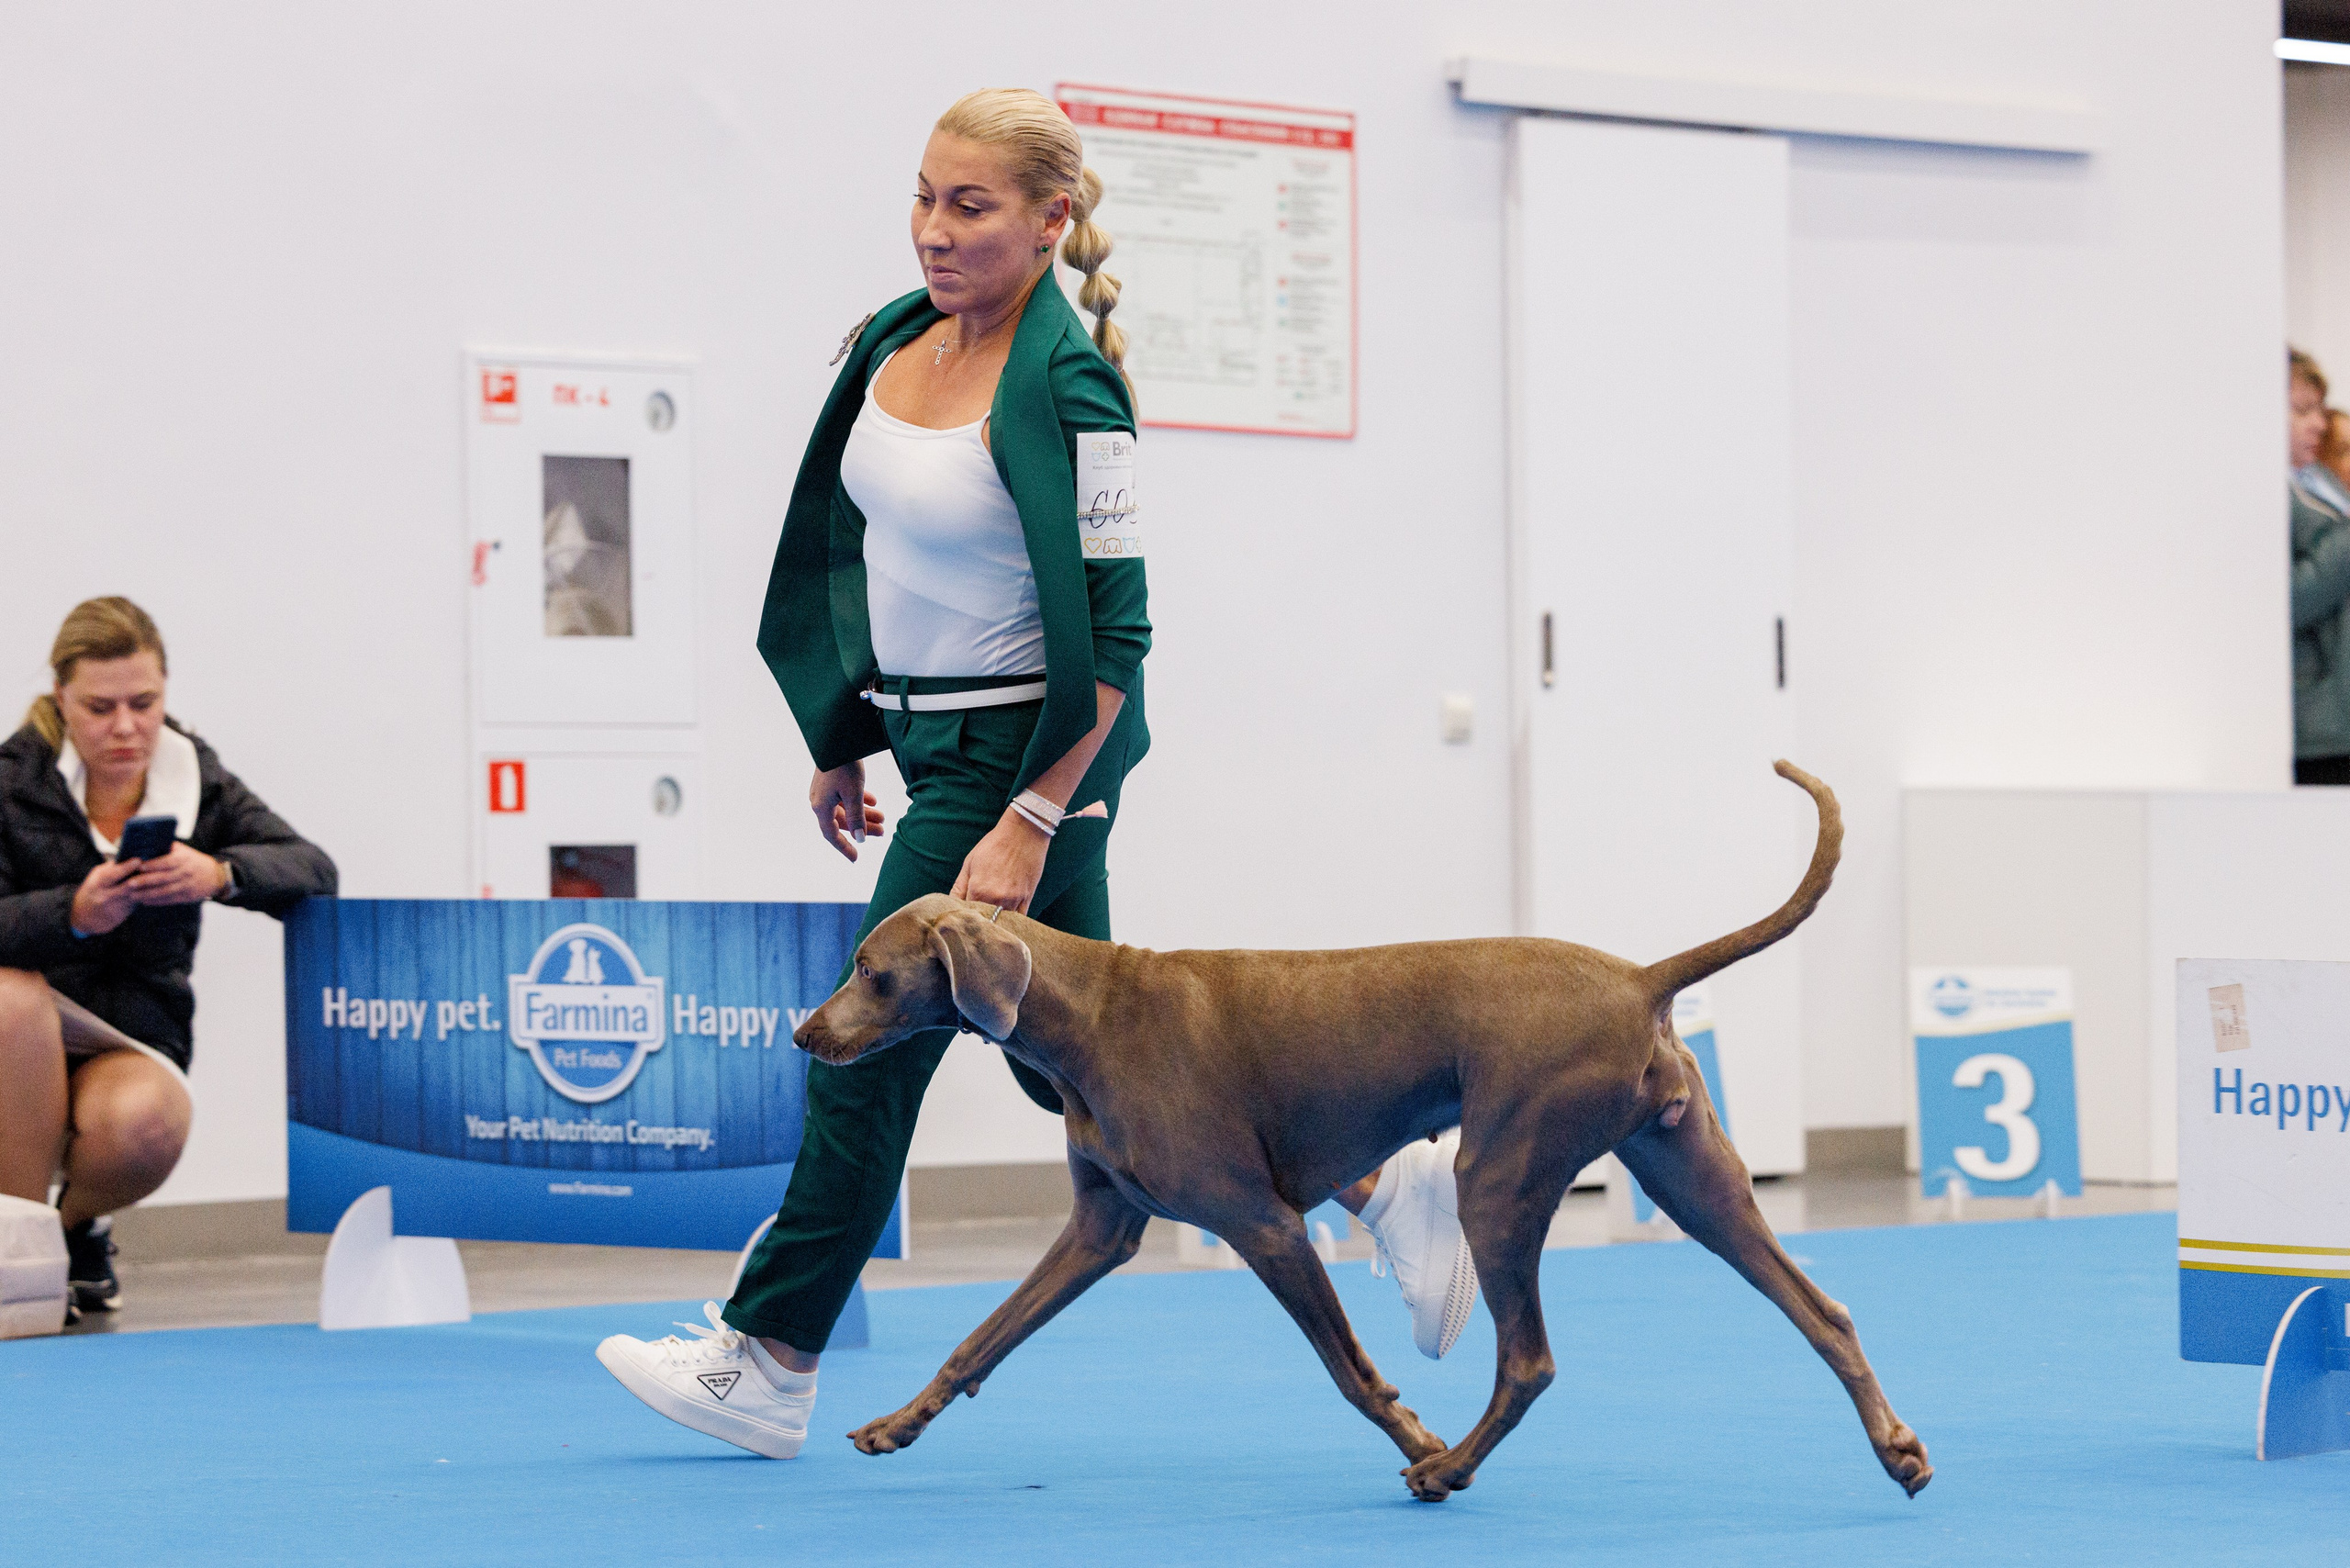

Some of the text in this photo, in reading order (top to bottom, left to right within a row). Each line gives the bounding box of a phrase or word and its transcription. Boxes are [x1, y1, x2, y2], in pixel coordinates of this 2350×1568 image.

[1113, 442, 1132, 456] Brit
[1089, 488, 1137, 529] 60
[323, 986, 501, 1041] Happy pet.
[526, 991, 648, 1032] Farmina
[673, 993, 779, 1048] Happy
[554, 1047, 577, 1068] Pet
[1952, 1053, 2041, 1181] 3
[2213, 1067, 2350, 1133] Happy
[464, 1114, 506, 1139] Your
[509, 1115, 540, 1140] Pet
[542, 1117, 624, 1143] Nutrition
